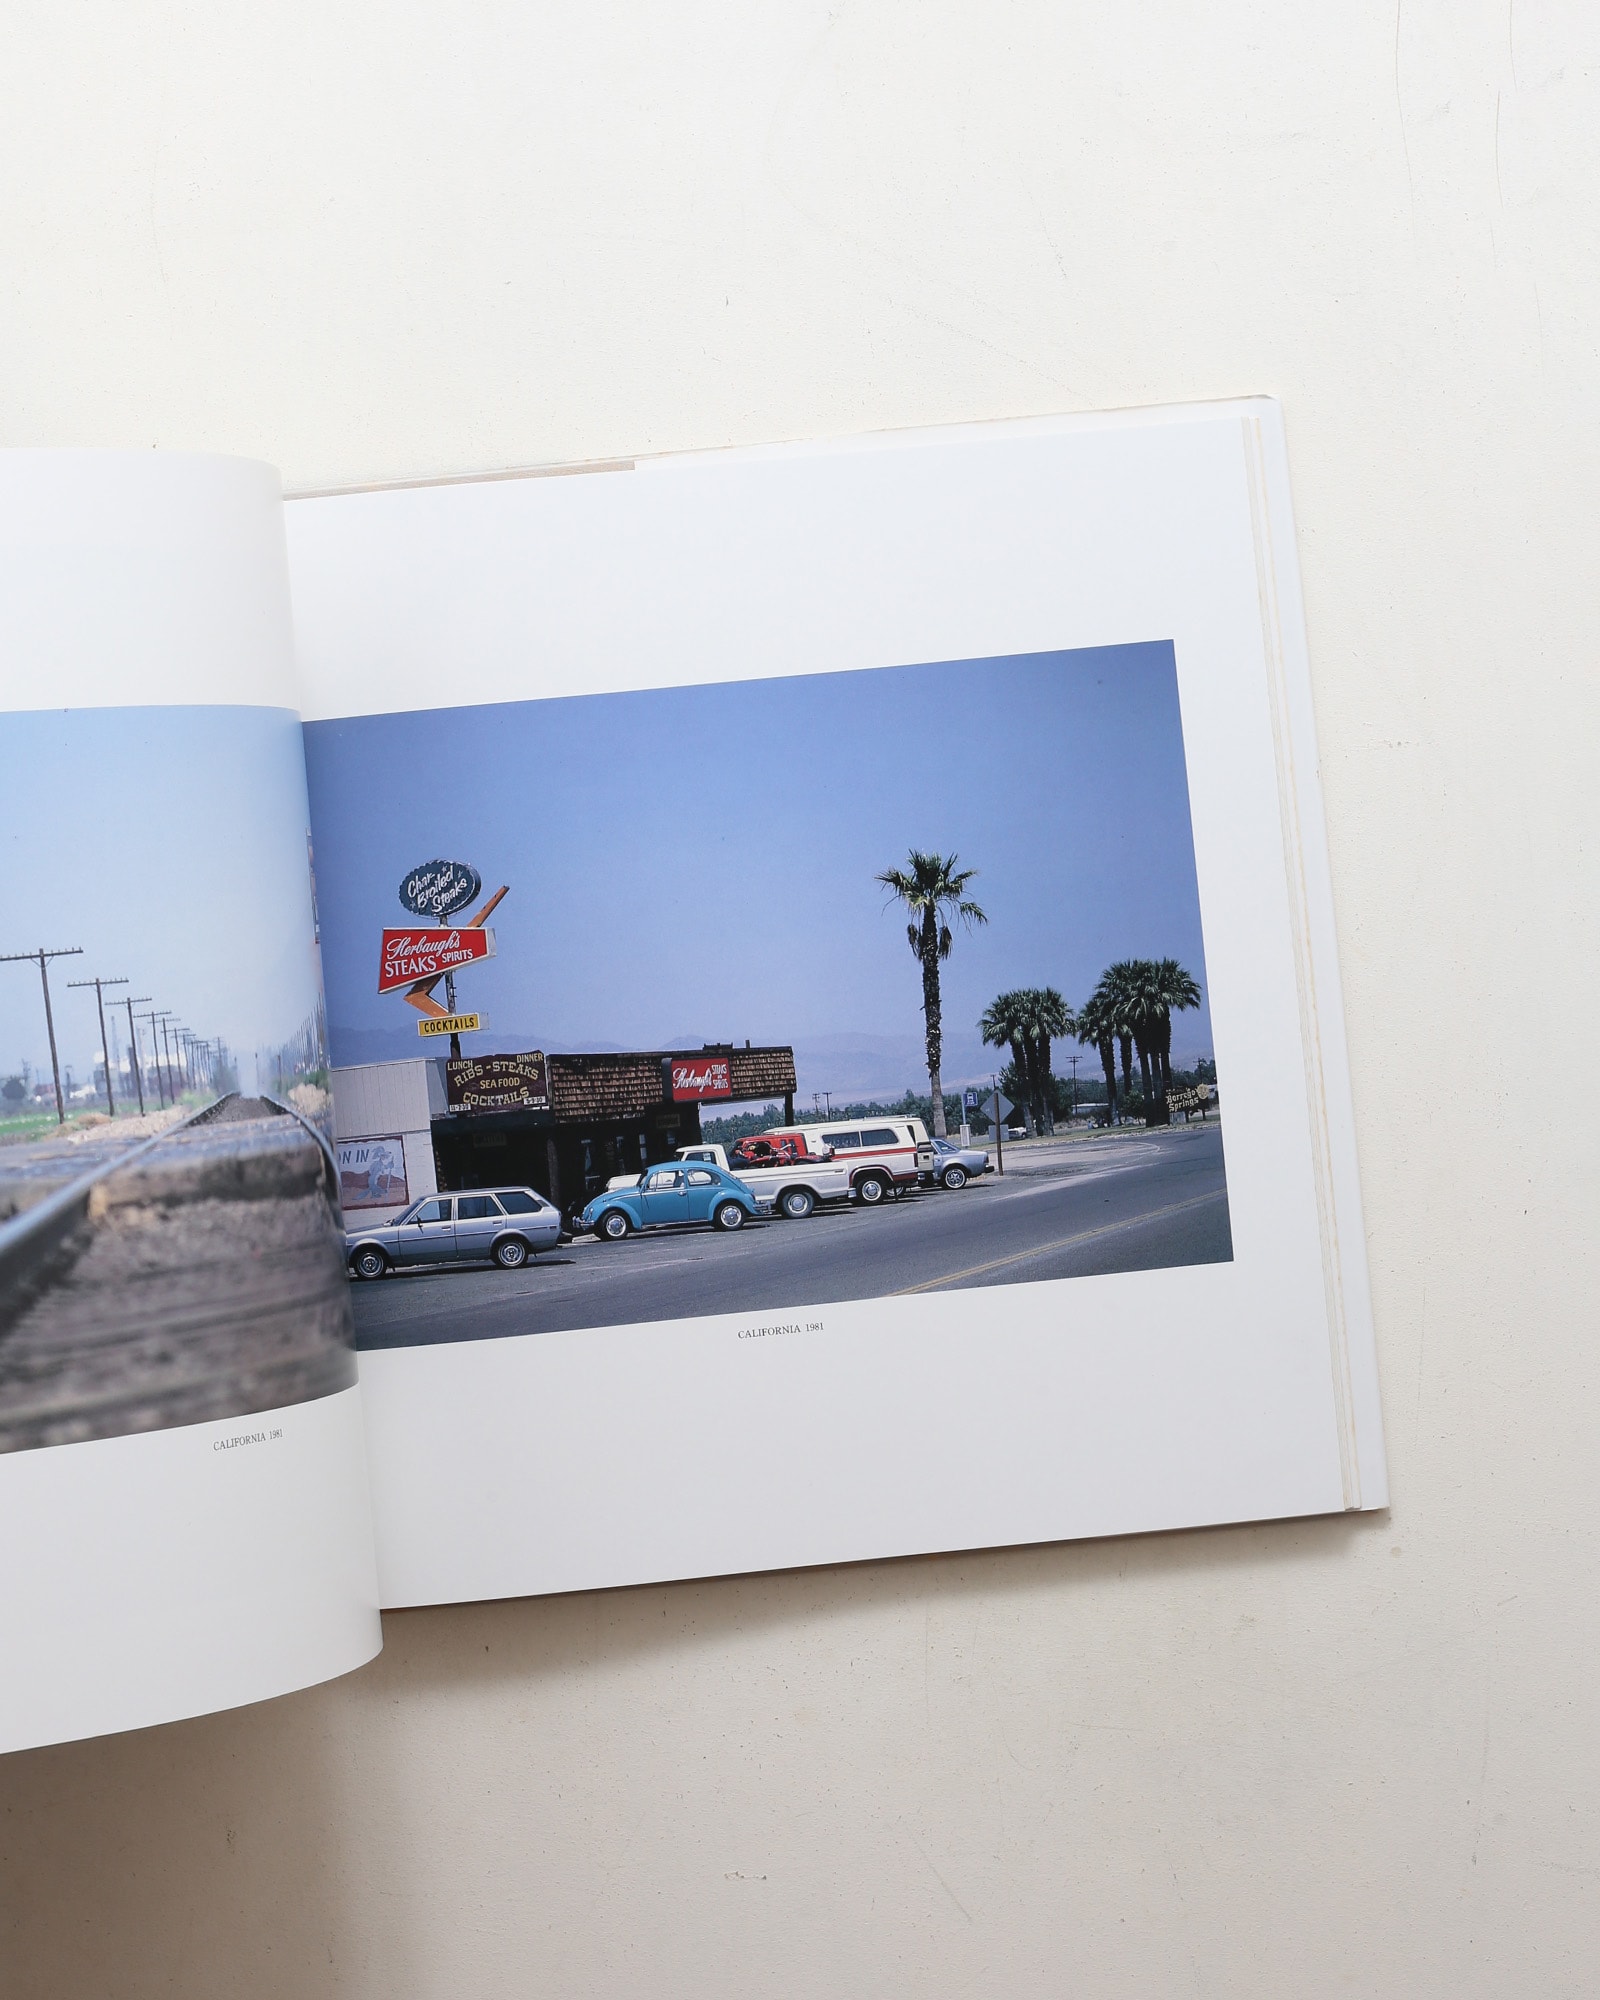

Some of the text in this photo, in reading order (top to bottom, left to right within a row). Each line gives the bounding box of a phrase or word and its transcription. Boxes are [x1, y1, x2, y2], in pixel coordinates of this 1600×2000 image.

[407, 871, 435, 898] Char-
[416, 865, 454, 908] Broiled
[431, 878, 467, 912] Steaks
[386, 930, 460, 960] Herbaugh's
[385, 948, 474, 978] STEAKS SPIRITS
[424, 1016, 474, 1033] COCKTAILS
[448, 1060, 473, 1070] LUNCH
[516, 1052, 544, 1063] DINNER
[454, 1064, 484, 1086] RIBS
[492, 1061, 539, 1080] STEAKS
[480, 1077, 520, 1090] SEA FOOD
[462, 1086, 530, 1106] COCKTAILS
[1168, 1096, 1199, 1112] Springs
[356, 1149, 370, 1163] IN
[738, 1322, 824, 1339] CALIFORNIA 1981
[213, 1428, 283, 1451] CALIFORNIA 1981
